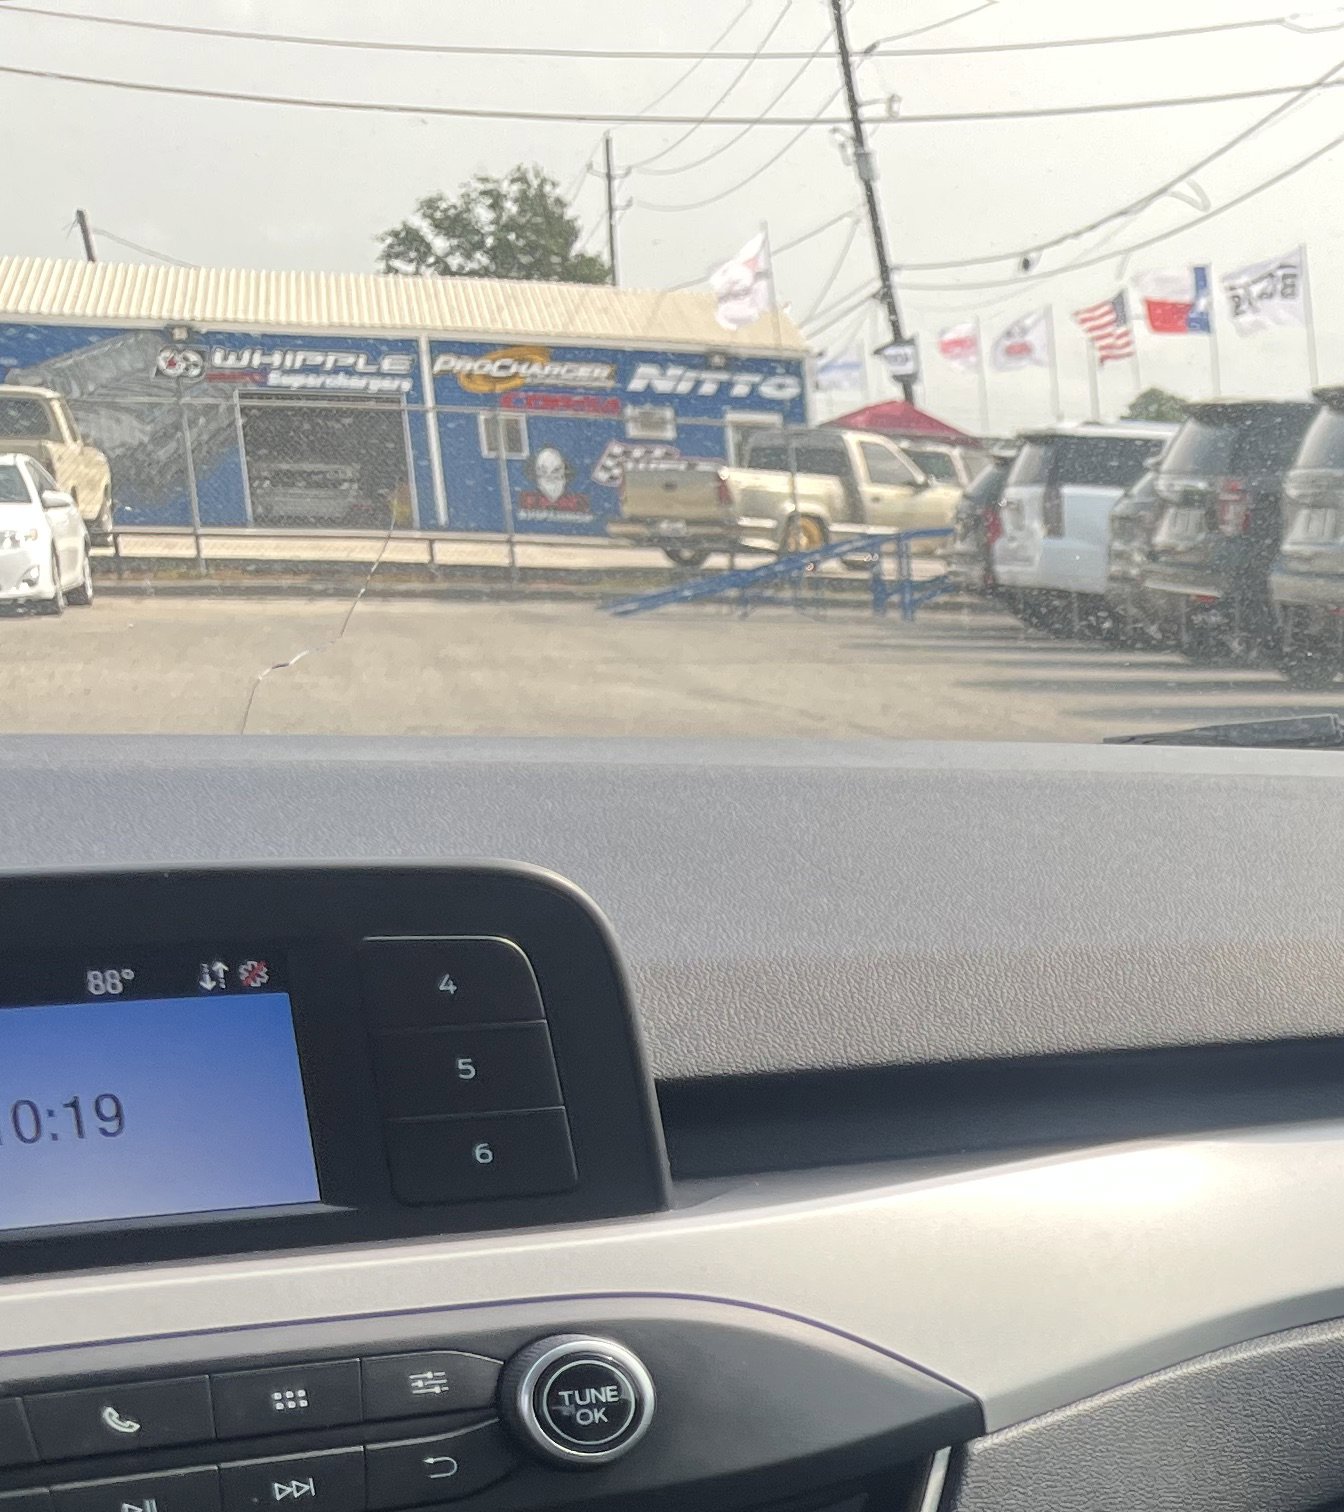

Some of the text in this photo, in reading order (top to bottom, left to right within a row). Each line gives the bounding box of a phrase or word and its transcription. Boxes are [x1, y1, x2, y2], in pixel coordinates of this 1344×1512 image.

[211, 347, 415, 374] WHIPPLE
[626, 362, 802, 400] NITTO
[438, 973, 457, 994] 4
[456, 1057, 477, 1080] 5
[0, 1093, 125, 1145] 0:19
[474, 1143, 494, 1164] 6
[558, 1385, 620, 1406] TUNE
[576, 1407, 609, 1426] OK
